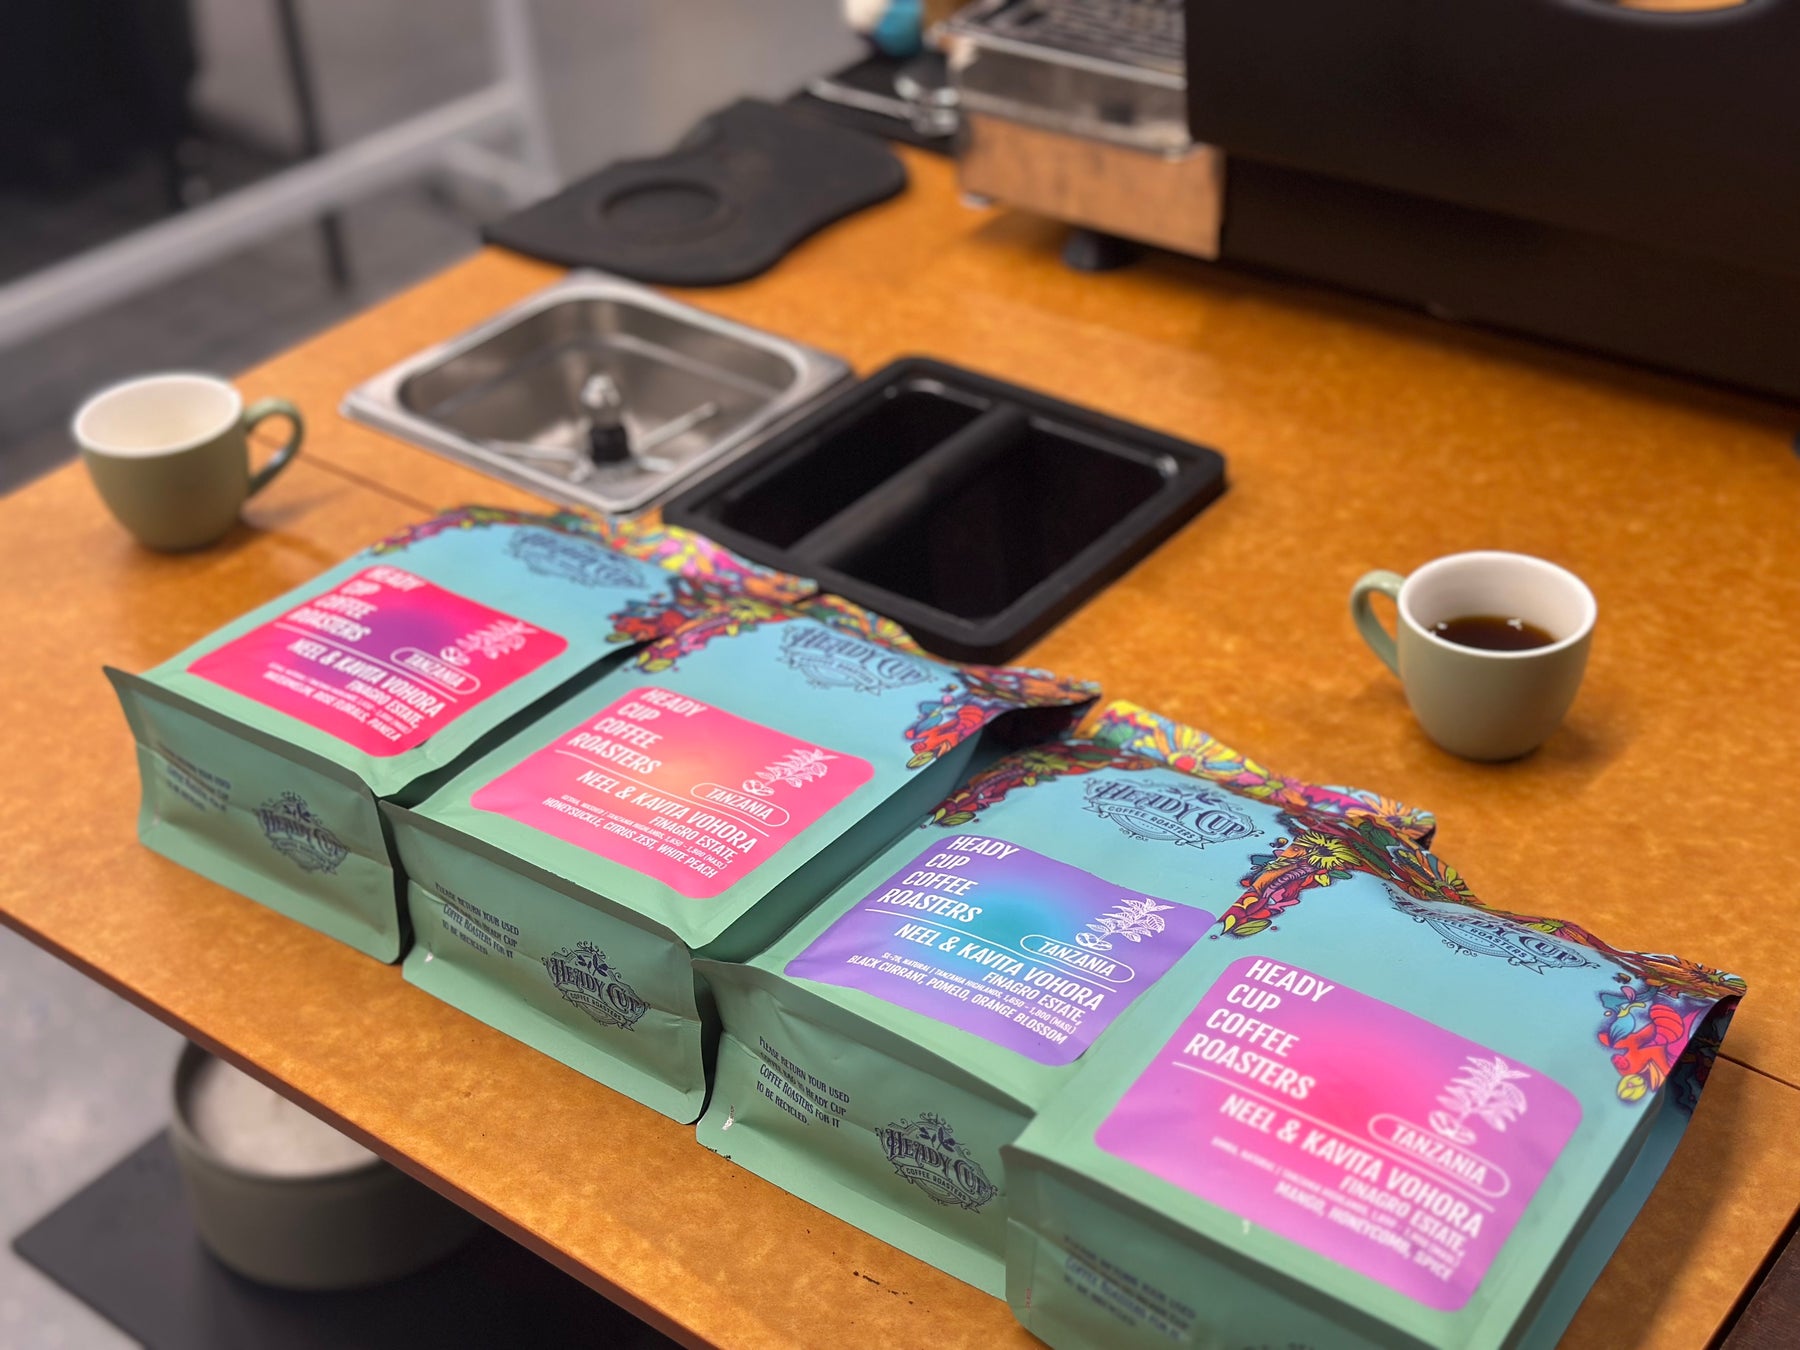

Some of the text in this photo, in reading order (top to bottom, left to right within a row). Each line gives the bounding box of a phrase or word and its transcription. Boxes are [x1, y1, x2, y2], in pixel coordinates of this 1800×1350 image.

[340, 580, 380, 596] CUP
[364, 567, 426, 592] HEADY
[286, 607, 372, 642] ROASTERS
[313, 594, 378, 620] COFFEE
[286, 638, 328, 661] NEEL
[319, 650, 342, 666] &
[332, 657, 389, 685] KAVITA
[381, 676, 445, 718] VOHORA
[404, 653, 466, 688] TANZANIA
[616, 701, 661, 722] CUP
[640, 689, 708, 718] HEADY
[593, 716, 663, 749] COFFEE
[566, 732, 662, 774] ROASTERS
[576, 770, 758, 854] NEEL & KAVITA VOHORA
[705, 788, 774, 820] TANZANIA
[1095, 782, 1246, 836] HEADY CUP
[542, 797, 719, 879] HONEYSUCKLE, CITRUS ZEST, WHITE PEACH
[648, 816, 738, 864] FINAGRO ESTATE,
[1107, 806, 1196, 839] COFFEE ROASTERS
[925, 853, 971, 870] CUP
[946, 836, 1019, 860] HEADY
[902, 870, 979, 897] COFFEE
[877, 888, 983, 923] ROASTERS
[464, 919, 492, 946] ROASTERS
[493, 940, 506, 955] FOR
[482, 911, 500, 927] YOUR
[501, 920, 520, 936] USED
[503, 934, 518, 947] CUP
[1038, 941, 1117, 976] TANZANIA
[1470, 928, 1527, 958] ROASTERS
[1519, 935, 1579, 962] CUP
[894, 923, 1105, 1011] NEEL & KAVITA VOHORA
[1245, 959, 1335, 1003] HEADY
[550, 957, 642, 1014] HEADY CUP
[846, 955, 1068, 1045] BLACK CURRANT, POMELO, ORANGE BLOSSOM
[902, 958, 930, 972] NATURAL
[934, 968, 966, 985] TANZANIA
[964, 979, 1003, 999] HIGHLANDS,
[1029, 1007, 1051, 1021] 1,800
[1049, 1016, 1077, 1035] (MASL)
[982, 971, 1086, 1026] FINAGRO ESTATE,
[1226, 983, 1281, 1013] CUP
[1206, 1008, 1300, 1057] COFFEE
[759, 1035, 850, 1104] PLEASE RETURN YOUR USED
[1183, 1032, 1317, 1100] ROASTERS
[756, 1080, 810, 1126] TO BE RECYCLED.
[760, 1063, 840, 1128] COFFEE ROASTERS FOR IT
[805, 1086, 828, 1109] HEADY
[830, 1102, 846, 1116] CUP
[886, 1128, 989, 1196] HEADY CUP
[1219, 1093, 1277, 1134] NEEL
[1276, 1118, 1302, 1143] &
[1301, 1129, 1384, 1183] KAVITA
[1386, 1166, 1484, 1239] VOHORA
[1390, 1124, 1487, 1185] TANZANIA
[906, 1167, 967, 1201] COFFEE ROASTERS
[1339, 1175, 1411, 1219] FINAGRO
[1410, 1210, 1467, 1258] ESTATE,
